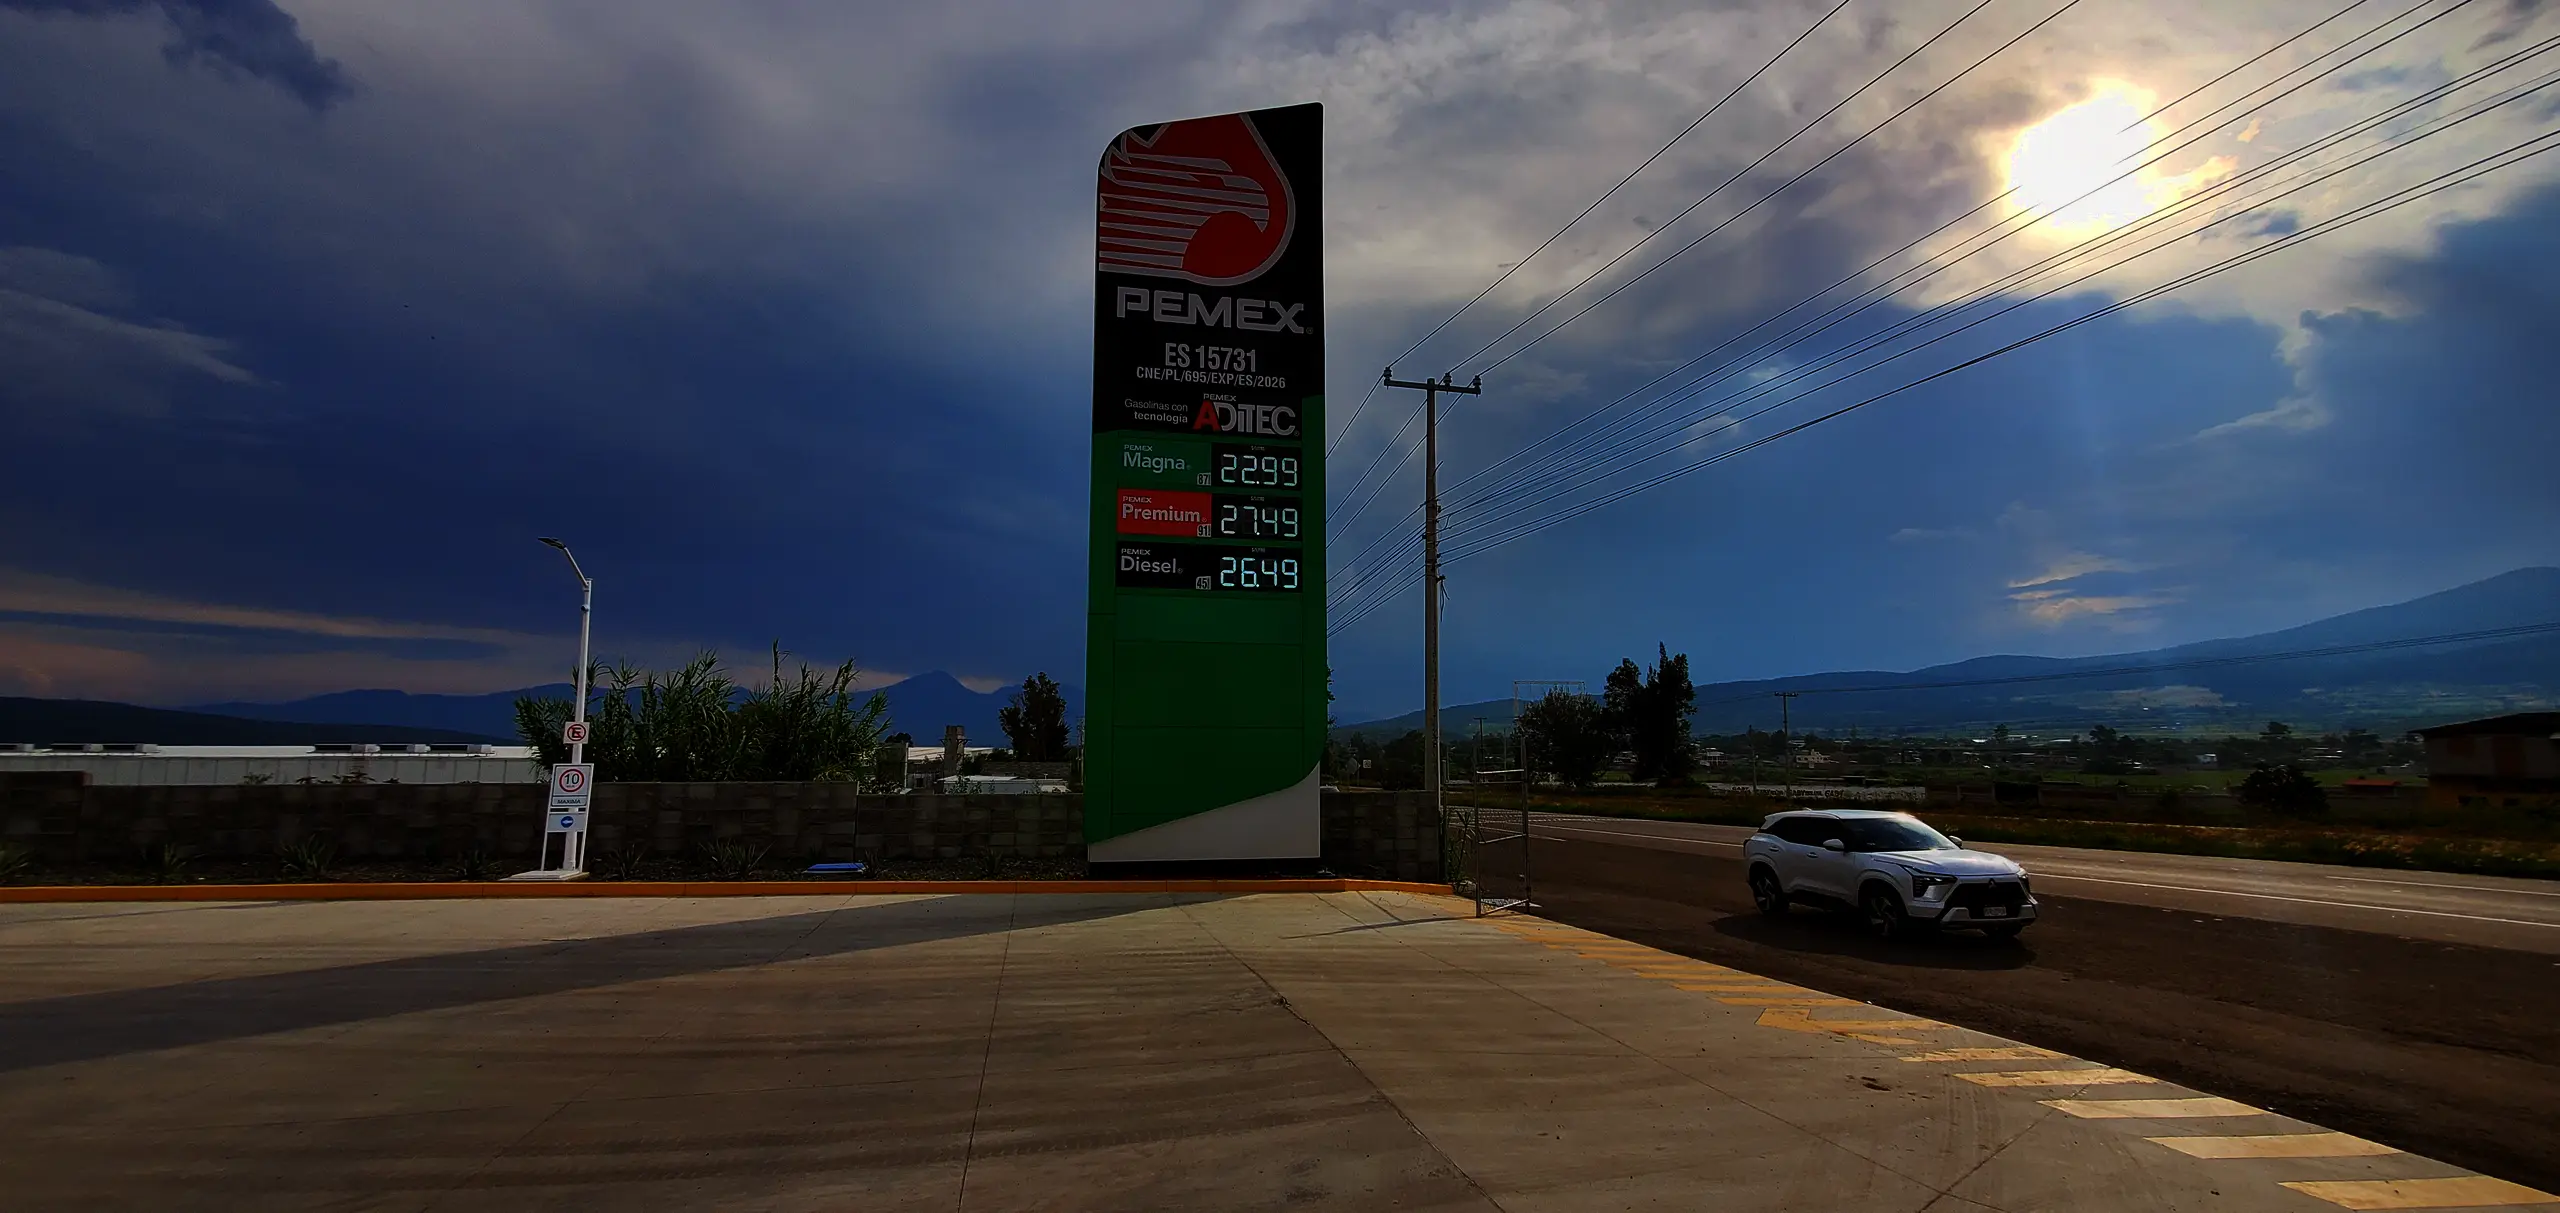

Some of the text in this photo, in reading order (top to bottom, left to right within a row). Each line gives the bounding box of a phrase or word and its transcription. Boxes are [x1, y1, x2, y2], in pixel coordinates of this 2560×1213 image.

[1116, 285, 1305, 335] PEMEX
[1165, 342, 1257, 373] ES 15731
[1136, 366, 1287, 389] CNE/PL/695/EXP/ES/2026
[1124, 398, 1188, 412] Gasolinas con
[1203, 393, 1237, 402] PEMEX
[1133, 411, 1188, 424] tecnología
[1124, 444, 1153, 452] PEMEX
[1123, 451, 1186, 474] Magna
[1220, 453, 1298, 487] 22.99
[1198, 474, 1208, 485] 87
[1122, 496, 1152, 504] PEMEX
[1121, 503, 1201, 523] Premium
[1220, 504, 1298, 537] 27.49
[1121, 548, 1151, 556] PEMEX
[1120, 555, 1177, 574] Diesel
[1219, 556, 1298, 589] 26.49
[564, 773, 580, 785] 10
